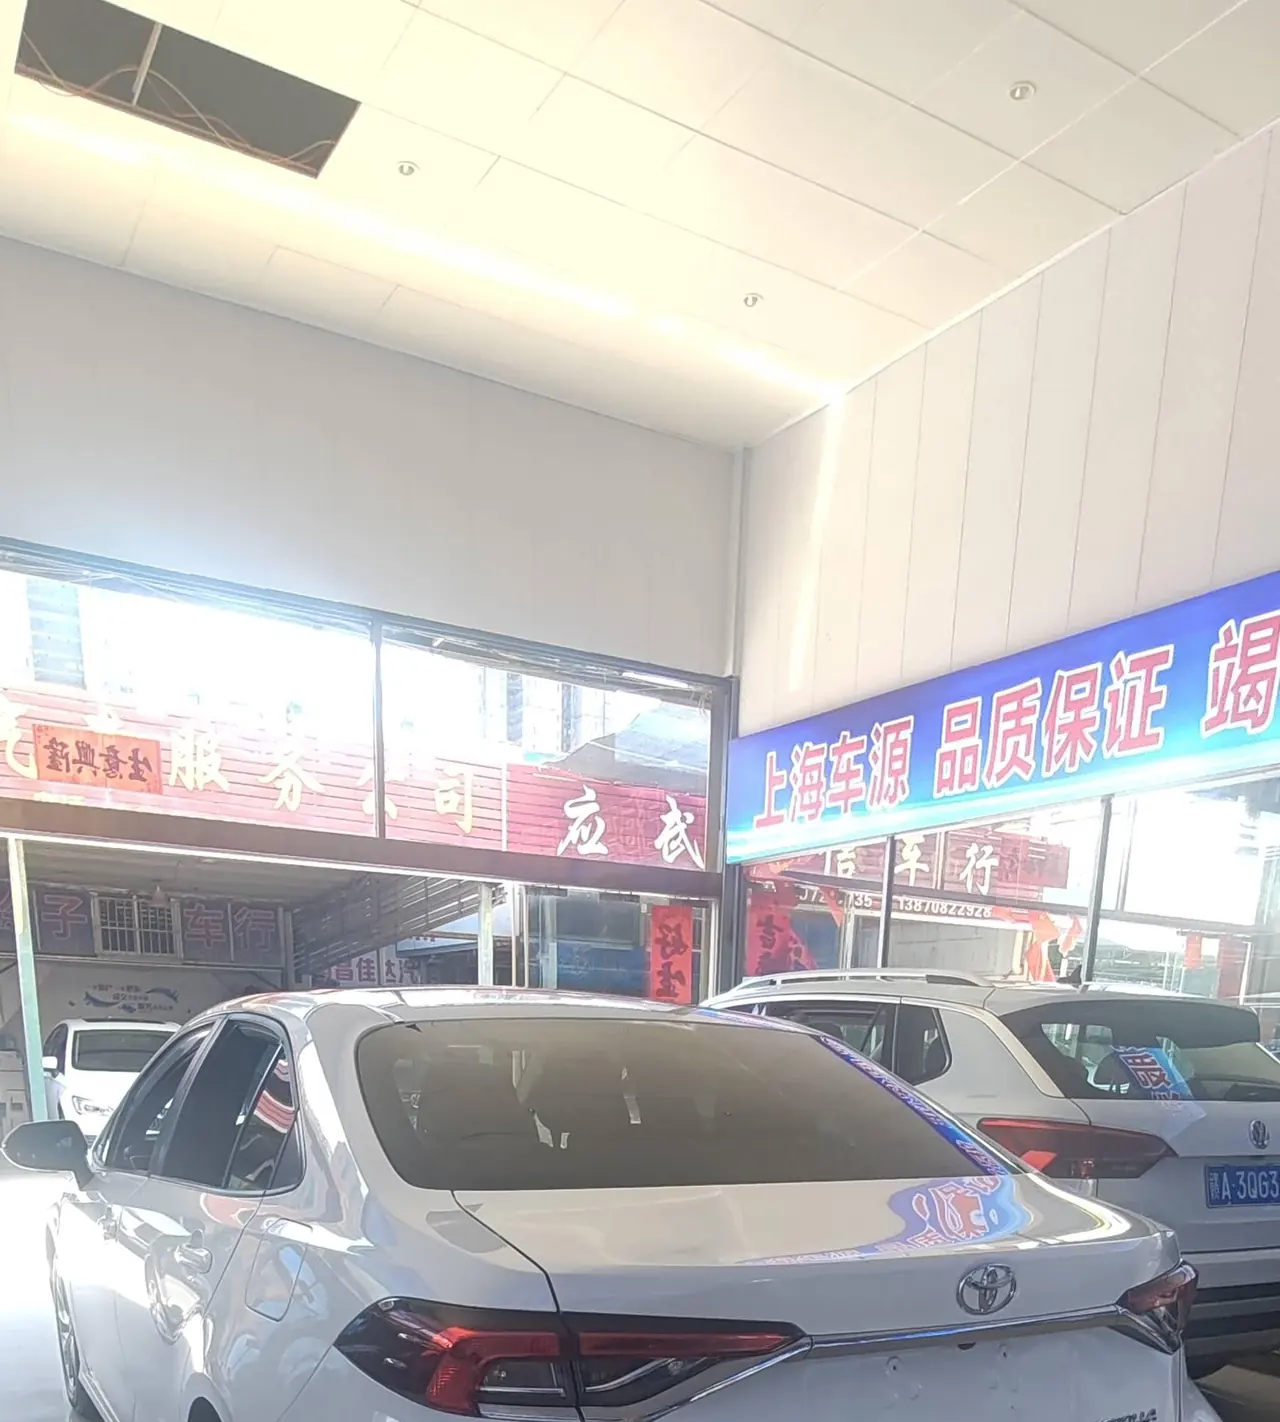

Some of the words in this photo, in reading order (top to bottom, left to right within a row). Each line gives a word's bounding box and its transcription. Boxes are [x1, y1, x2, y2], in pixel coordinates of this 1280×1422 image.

[753, 714, 914, 833] 上海车源
[931, 642, 1177, 801] 品质保证
